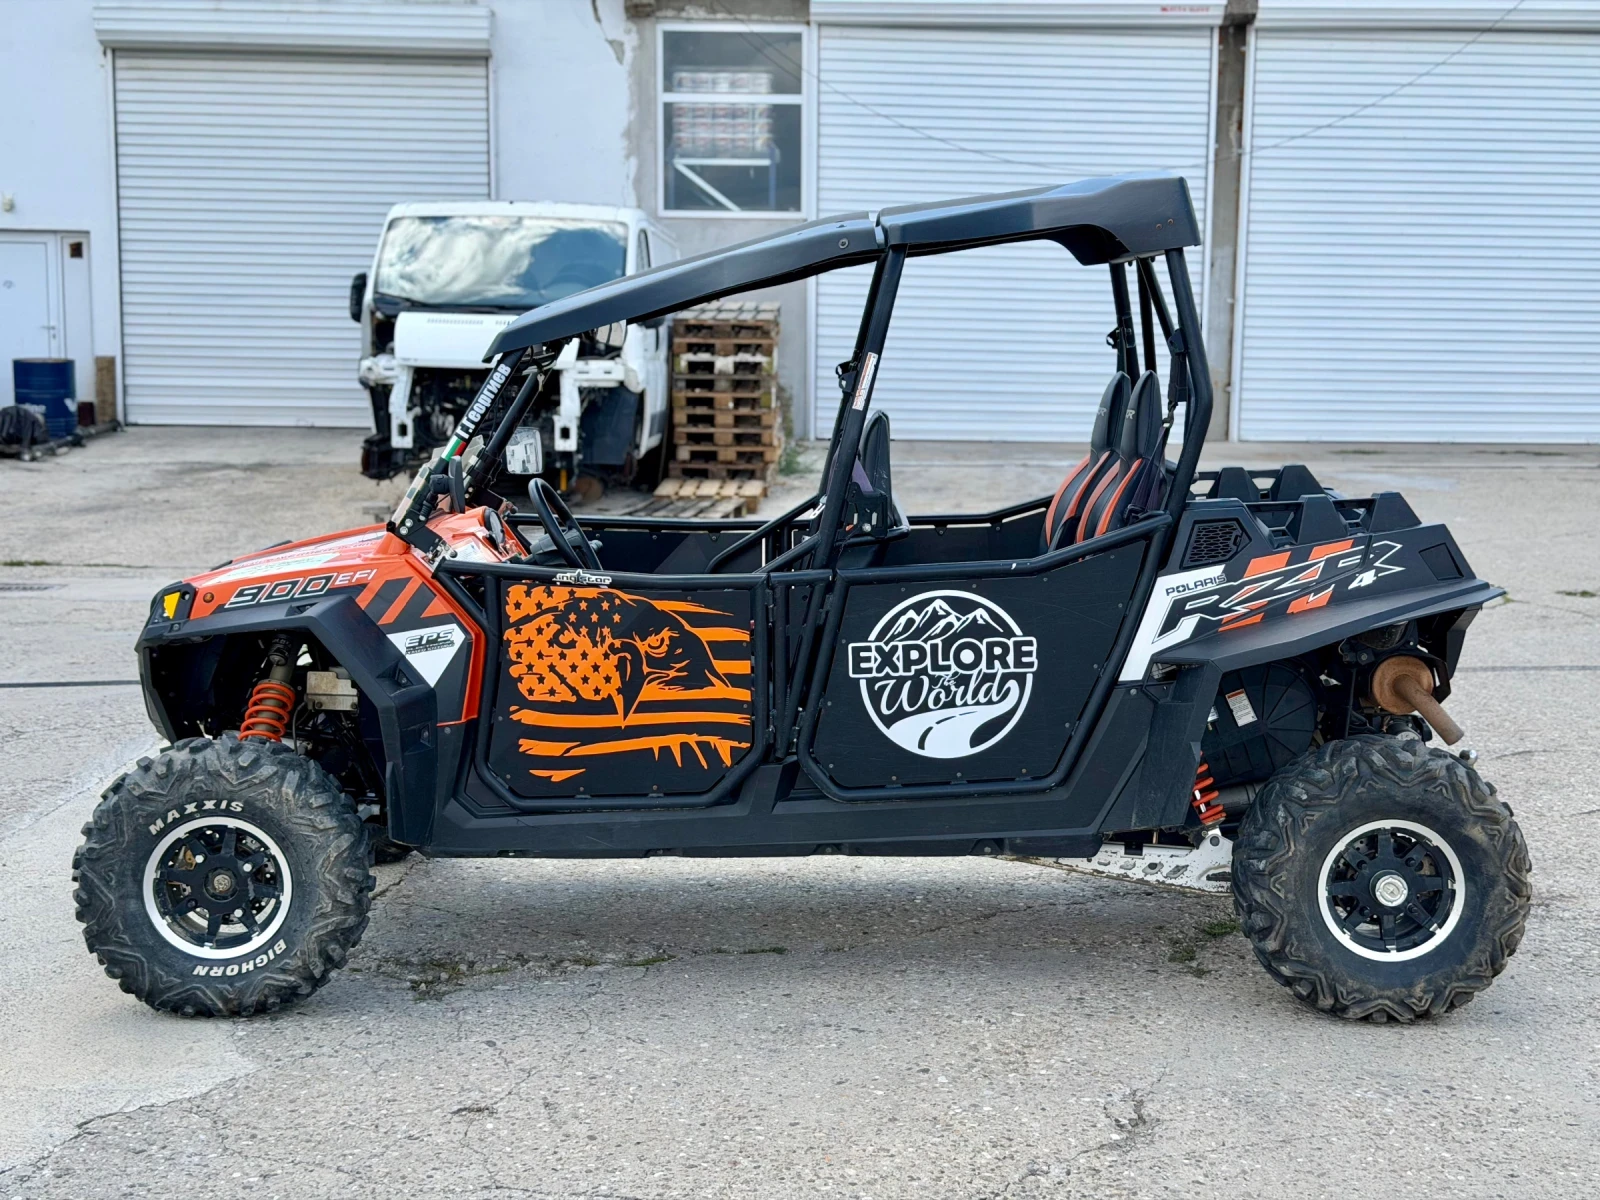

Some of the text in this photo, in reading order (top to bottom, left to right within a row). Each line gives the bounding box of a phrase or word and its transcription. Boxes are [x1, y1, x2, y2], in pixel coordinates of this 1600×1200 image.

[223, 568, 378, 610] 900 EFI
[1165, 573, 1227, 597] POLARIS
[1348, 569, 1377, 590] 4
[405, 628, 455, 648] EPS
[848, 636, 1038, 678] EXPLORE
[874, 666, 1004, 716] World
[148, 799, 245, 836] MAXXIS
[192, 938, 287, 978] BIGHORN
